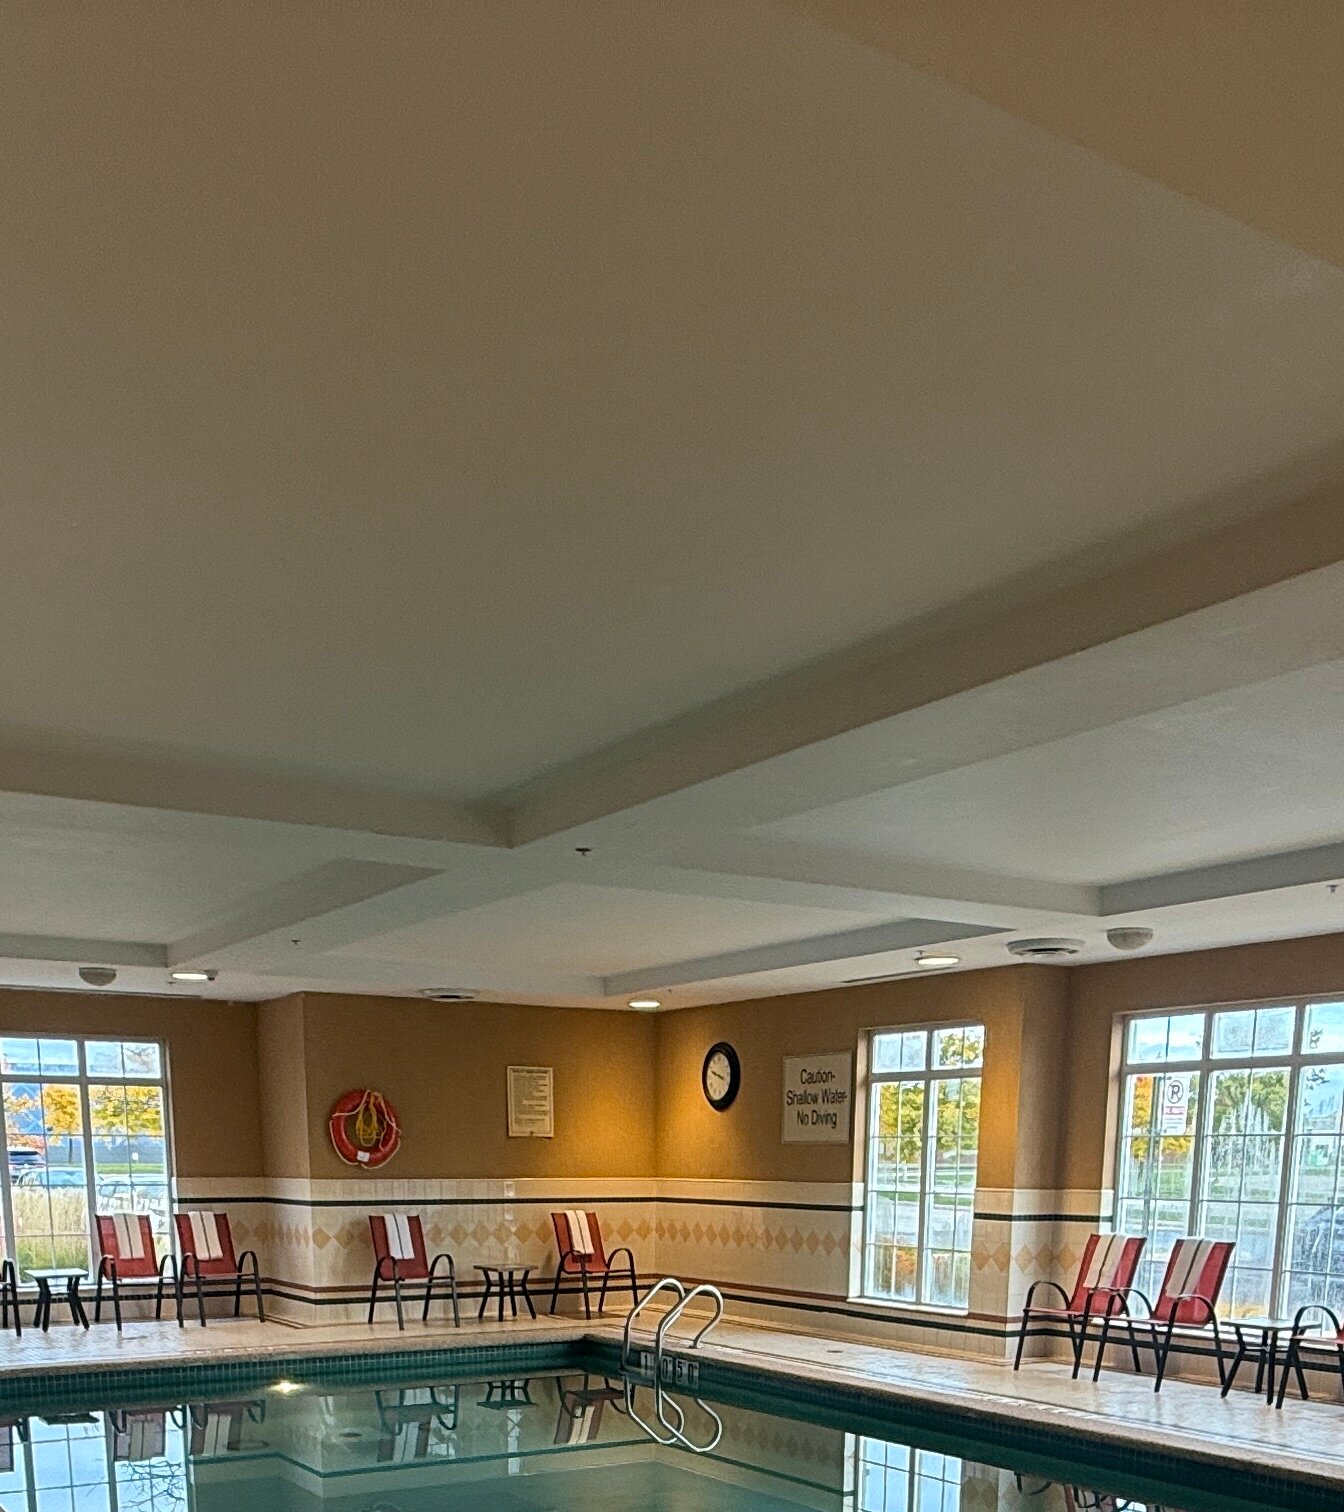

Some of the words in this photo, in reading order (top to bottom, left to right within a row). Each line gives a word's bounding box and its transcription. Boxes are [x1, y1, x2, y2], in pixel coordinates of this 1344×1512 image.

[786, 1089, 819, 1106] Shallow
[797, 1110, 809, 1126] No
[811, 1109, 838, 1129] Diving
